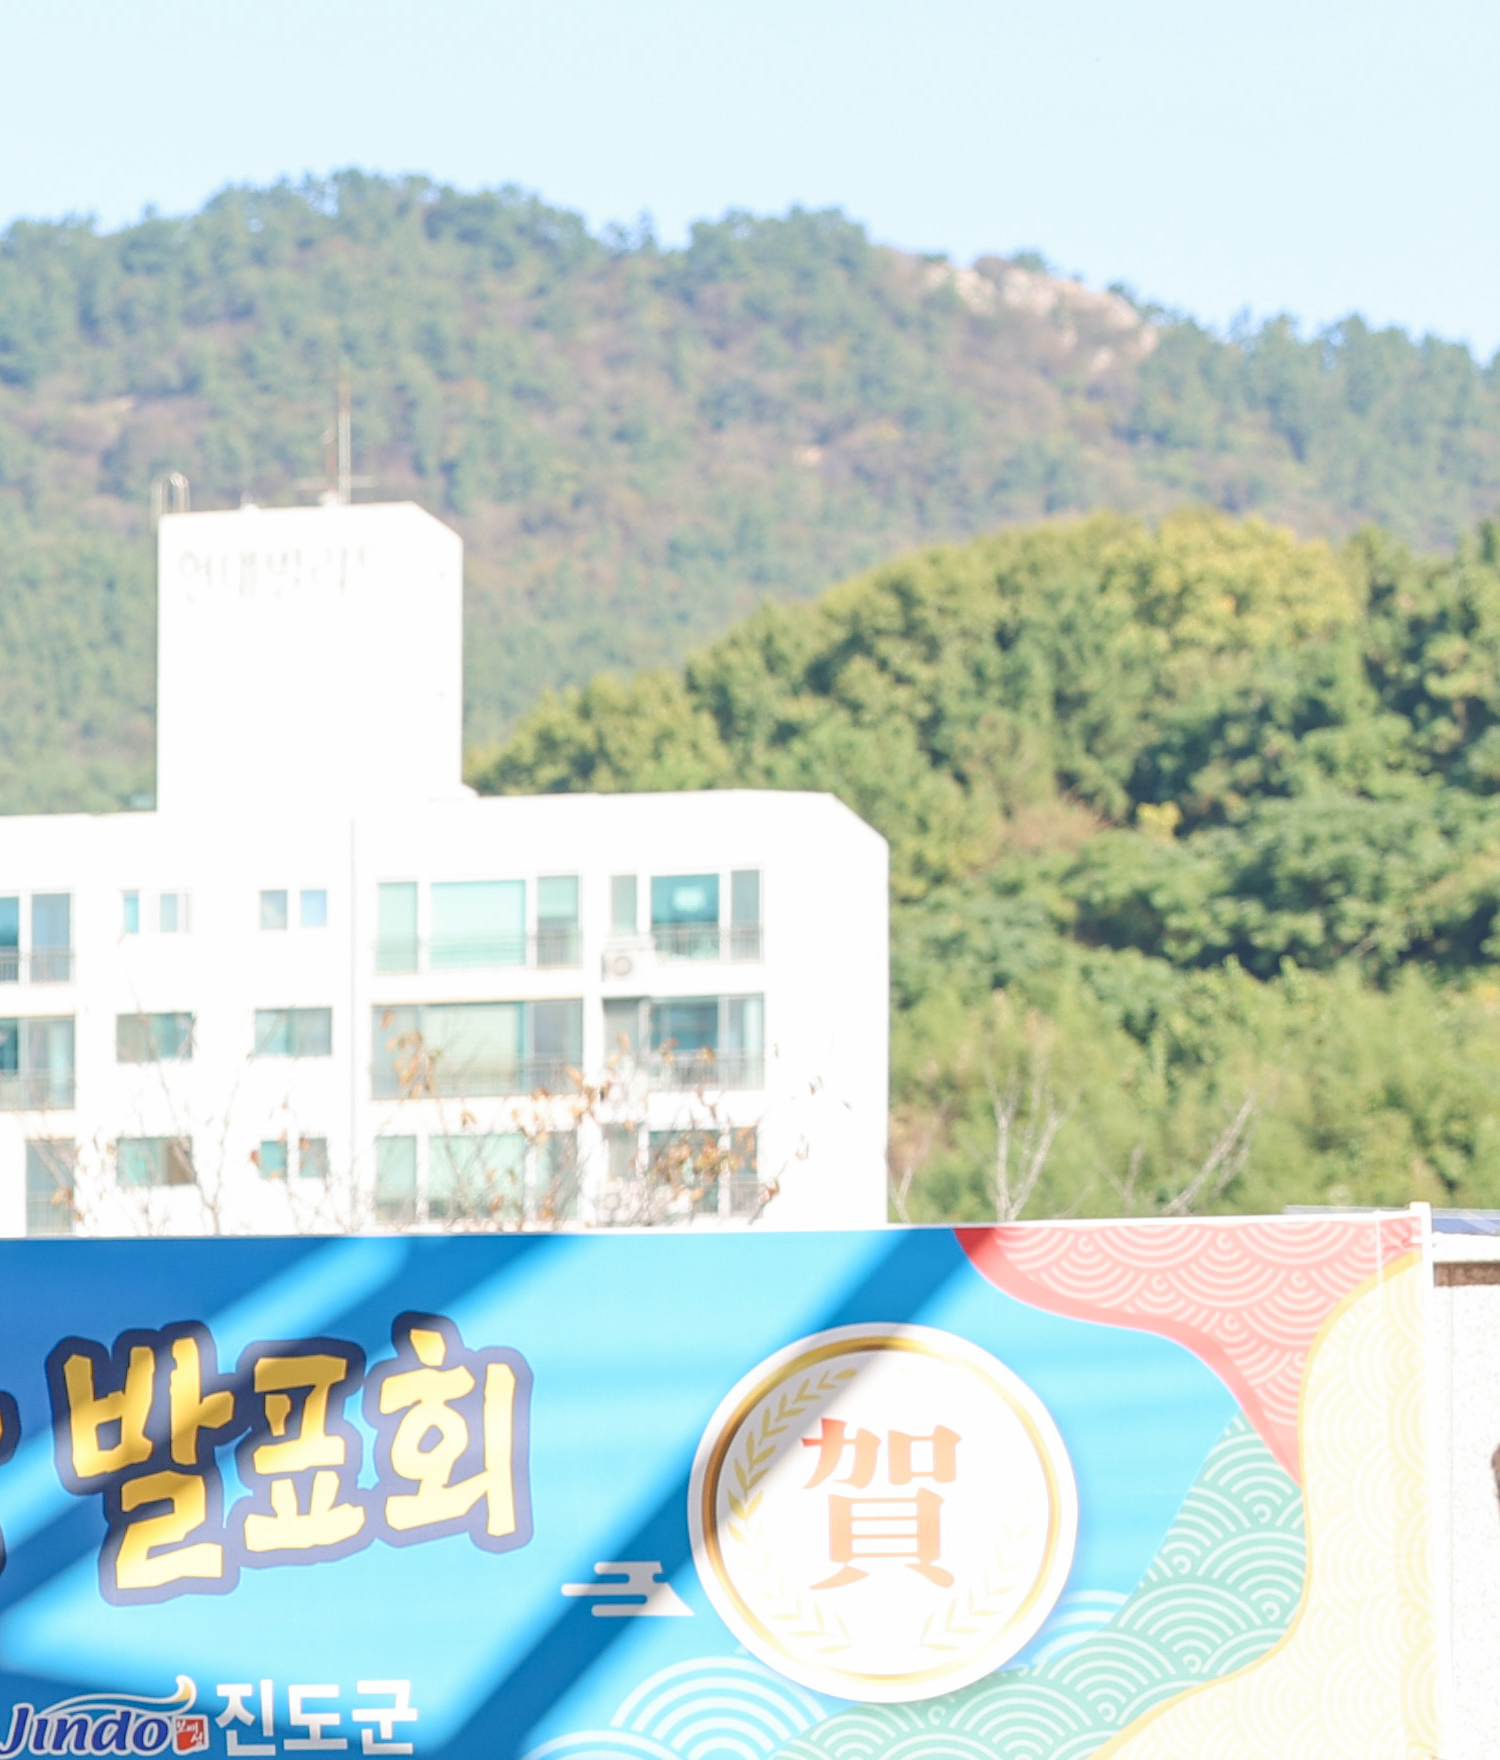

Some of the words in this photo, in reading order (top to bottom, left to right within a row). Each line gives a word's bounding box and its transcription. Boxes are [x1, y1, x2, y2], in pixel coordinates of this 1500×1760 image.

[55, 1320, 523, 1597] 발표회
[800, 1418, 962, 1589] 賀
[215, 1680, 418, 1757] 진도군
